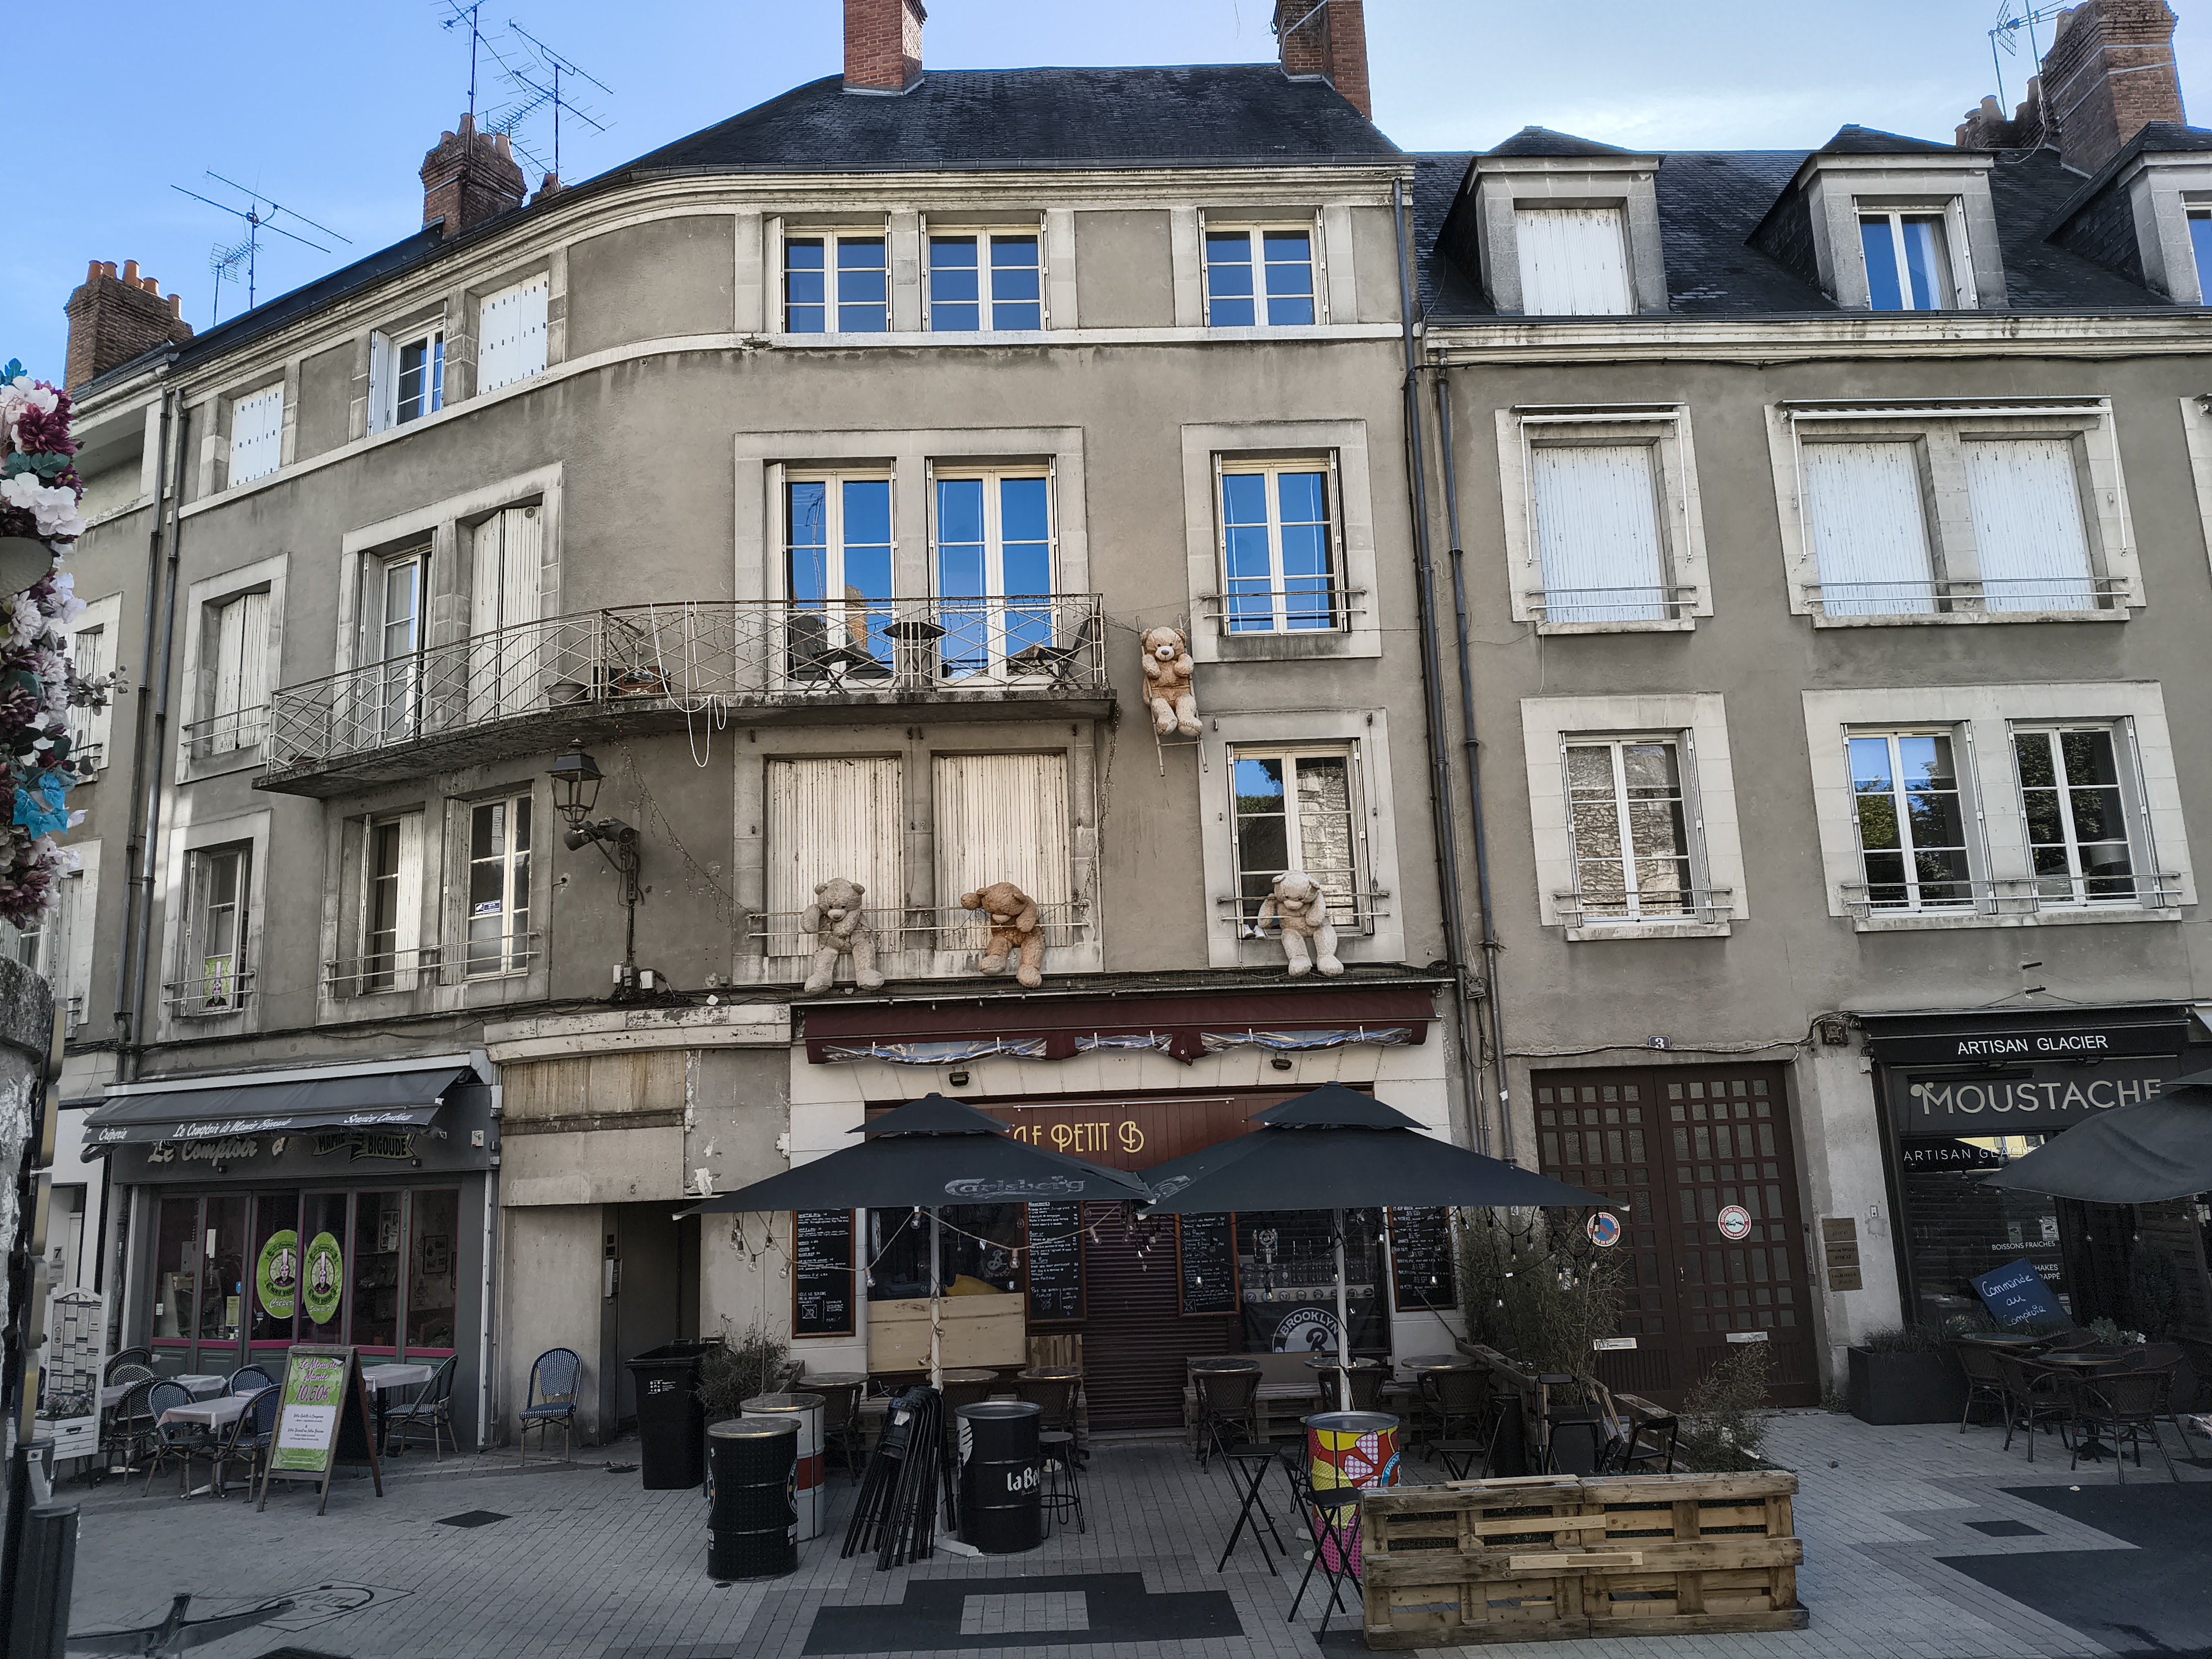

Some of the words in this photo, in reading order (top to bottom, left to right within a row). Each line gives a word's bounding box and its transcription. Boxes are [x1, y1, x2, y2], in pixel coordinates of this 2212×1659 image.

[1655, 1037, 1665, 1048] 3
[1958, 1038, 2028, 1055] ARTISAN
[2037, 1035, 2109, 1051] GLACIER
[1911, 1079, 2161, 1115] MOUSTACHE
[99, 1125, 127, 1141] Crêperie
[173, 1124, 185, 1137] Le
[187, 1122, 219, 1138] Comptoir
[219, 1122, 230, 1134] de
[1050, 1123, 1110, 1153] PETIT
[1118, 1121, 1144, 1153] B
[147, 1141, 175, 1163] Le
[181, 1136, 258, 1167] Comptoir
[1904, 1149, 1971, 1162] ARTISAN
[945, 1176, 1085, 1199] Carlsberg
[54, 1249, 61, 1258] 7
[1992, 1242, 2024, 1250] BOISSONS
[1982, 1274, 2033, 1297] Commande
[2006, 1295, 2026, 1306] au
[1280, 1312, 1339, 1336] BROOKLYN
[2004, 1305, 2047, 1326] Comptoir
[298, 1358, 309, 1370] Le
[308, 1358, 328, 1370] Menu
[329, 1361, 339, 1369] de
[304, 1370, 328, 1382] Mamie
[296, 1384, 331, 1402] 10,50€
[1007, 1472, 1022, 1492] la
